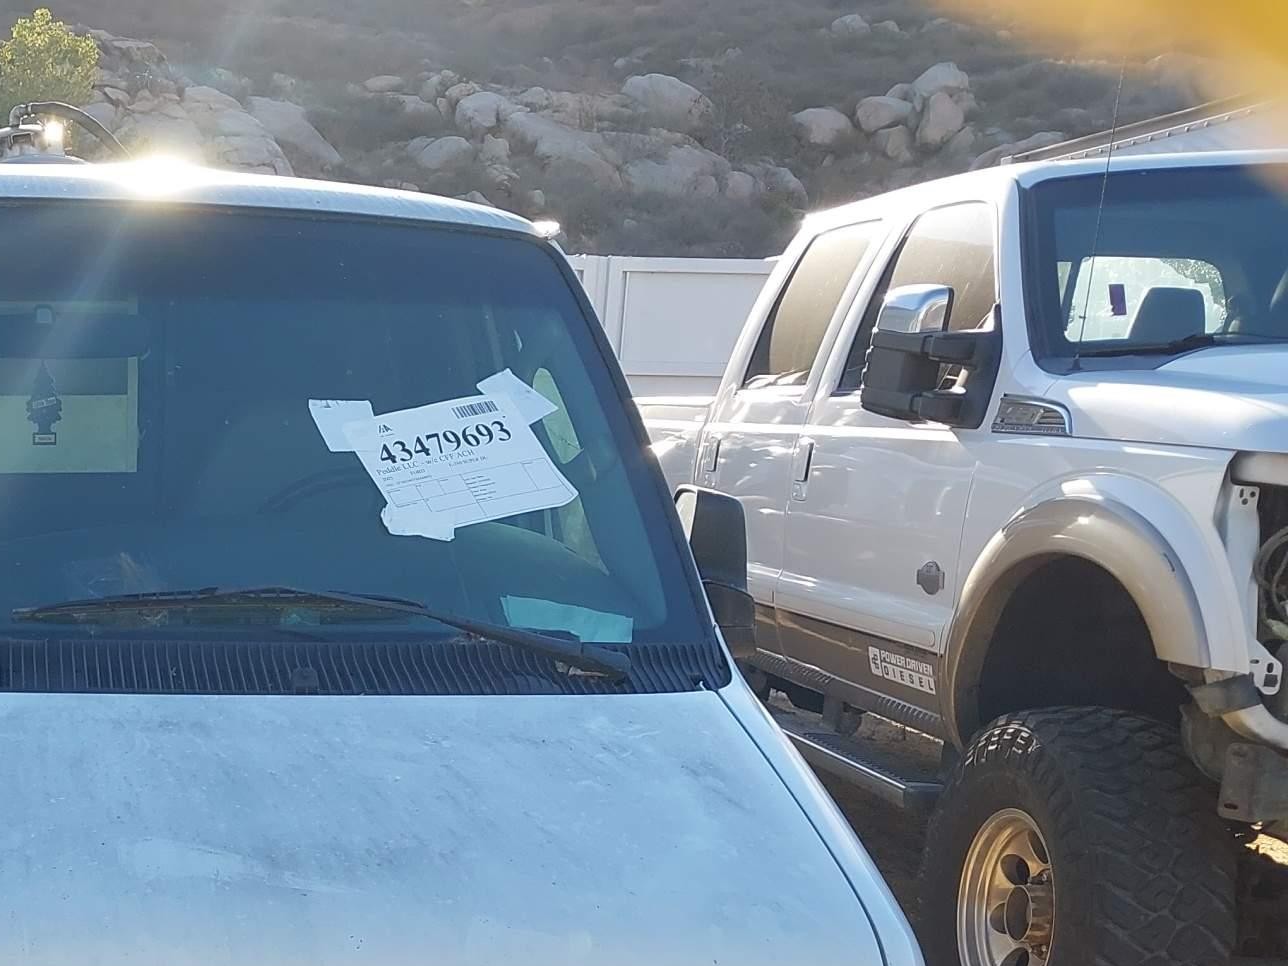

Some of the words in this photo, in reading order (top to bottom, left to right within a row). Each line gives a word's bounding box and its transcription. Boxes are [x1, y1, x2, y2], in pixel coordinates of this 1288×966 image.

[380, 420, 511, 464] 43479693
[376, 464, 402, 476] Peddle
[403, 461, 419, 470] LLC
[880, 650, 906, 668] POWER
[906, 658, 933, 676] DRIVEN
[883, 664, 934, 691] DIESEL
